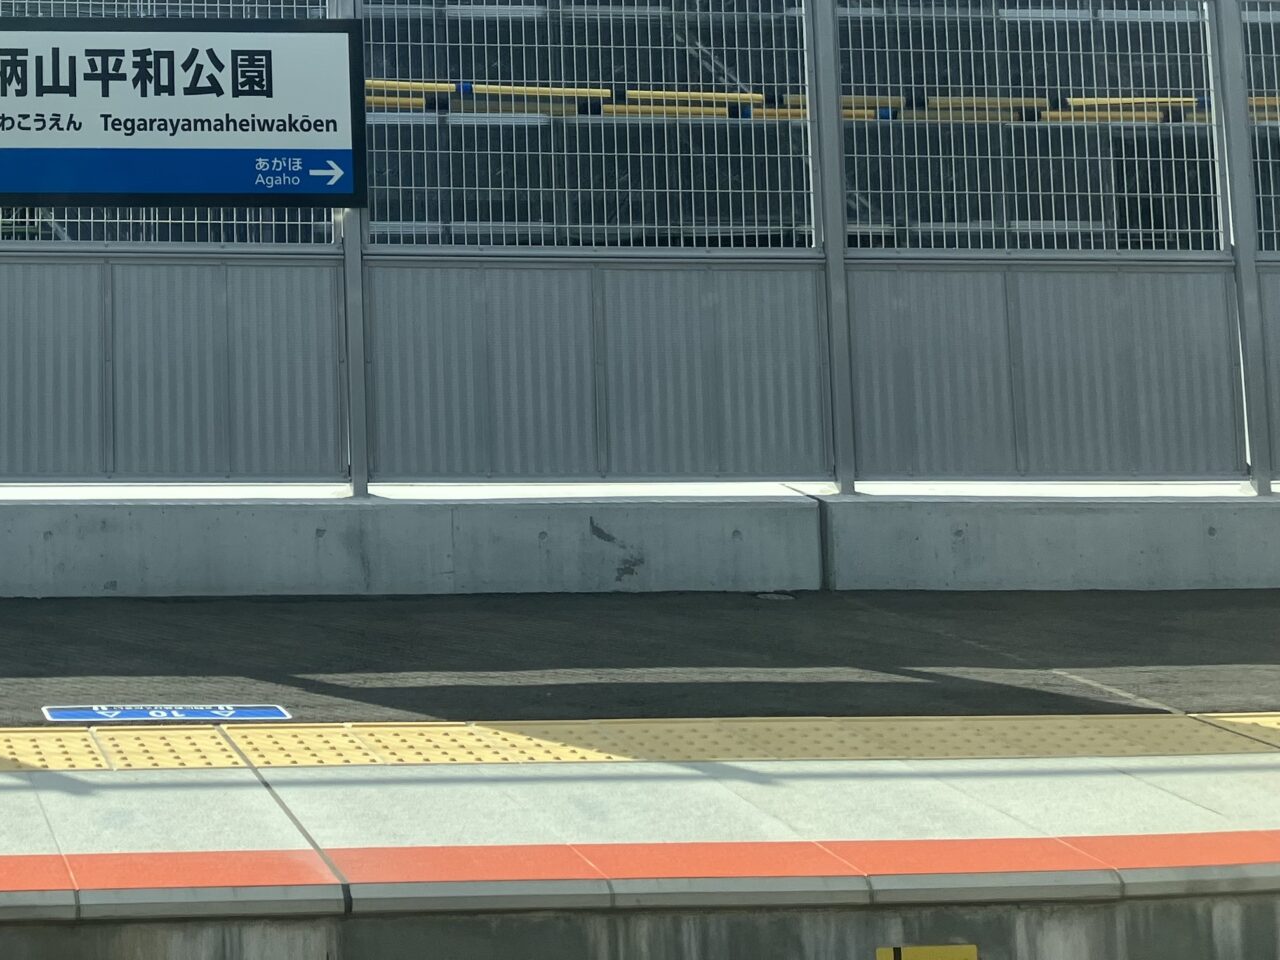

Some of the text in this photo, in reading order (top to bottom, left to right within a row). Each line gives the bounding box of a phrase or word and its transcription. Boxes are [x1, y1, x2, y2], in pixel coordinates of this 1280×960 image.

[99, 112, 339, 138] Tegarayamaheiwakōen
[255, 157, 303, 172] あがほ
[254, 172, 301, 189] Agaho
